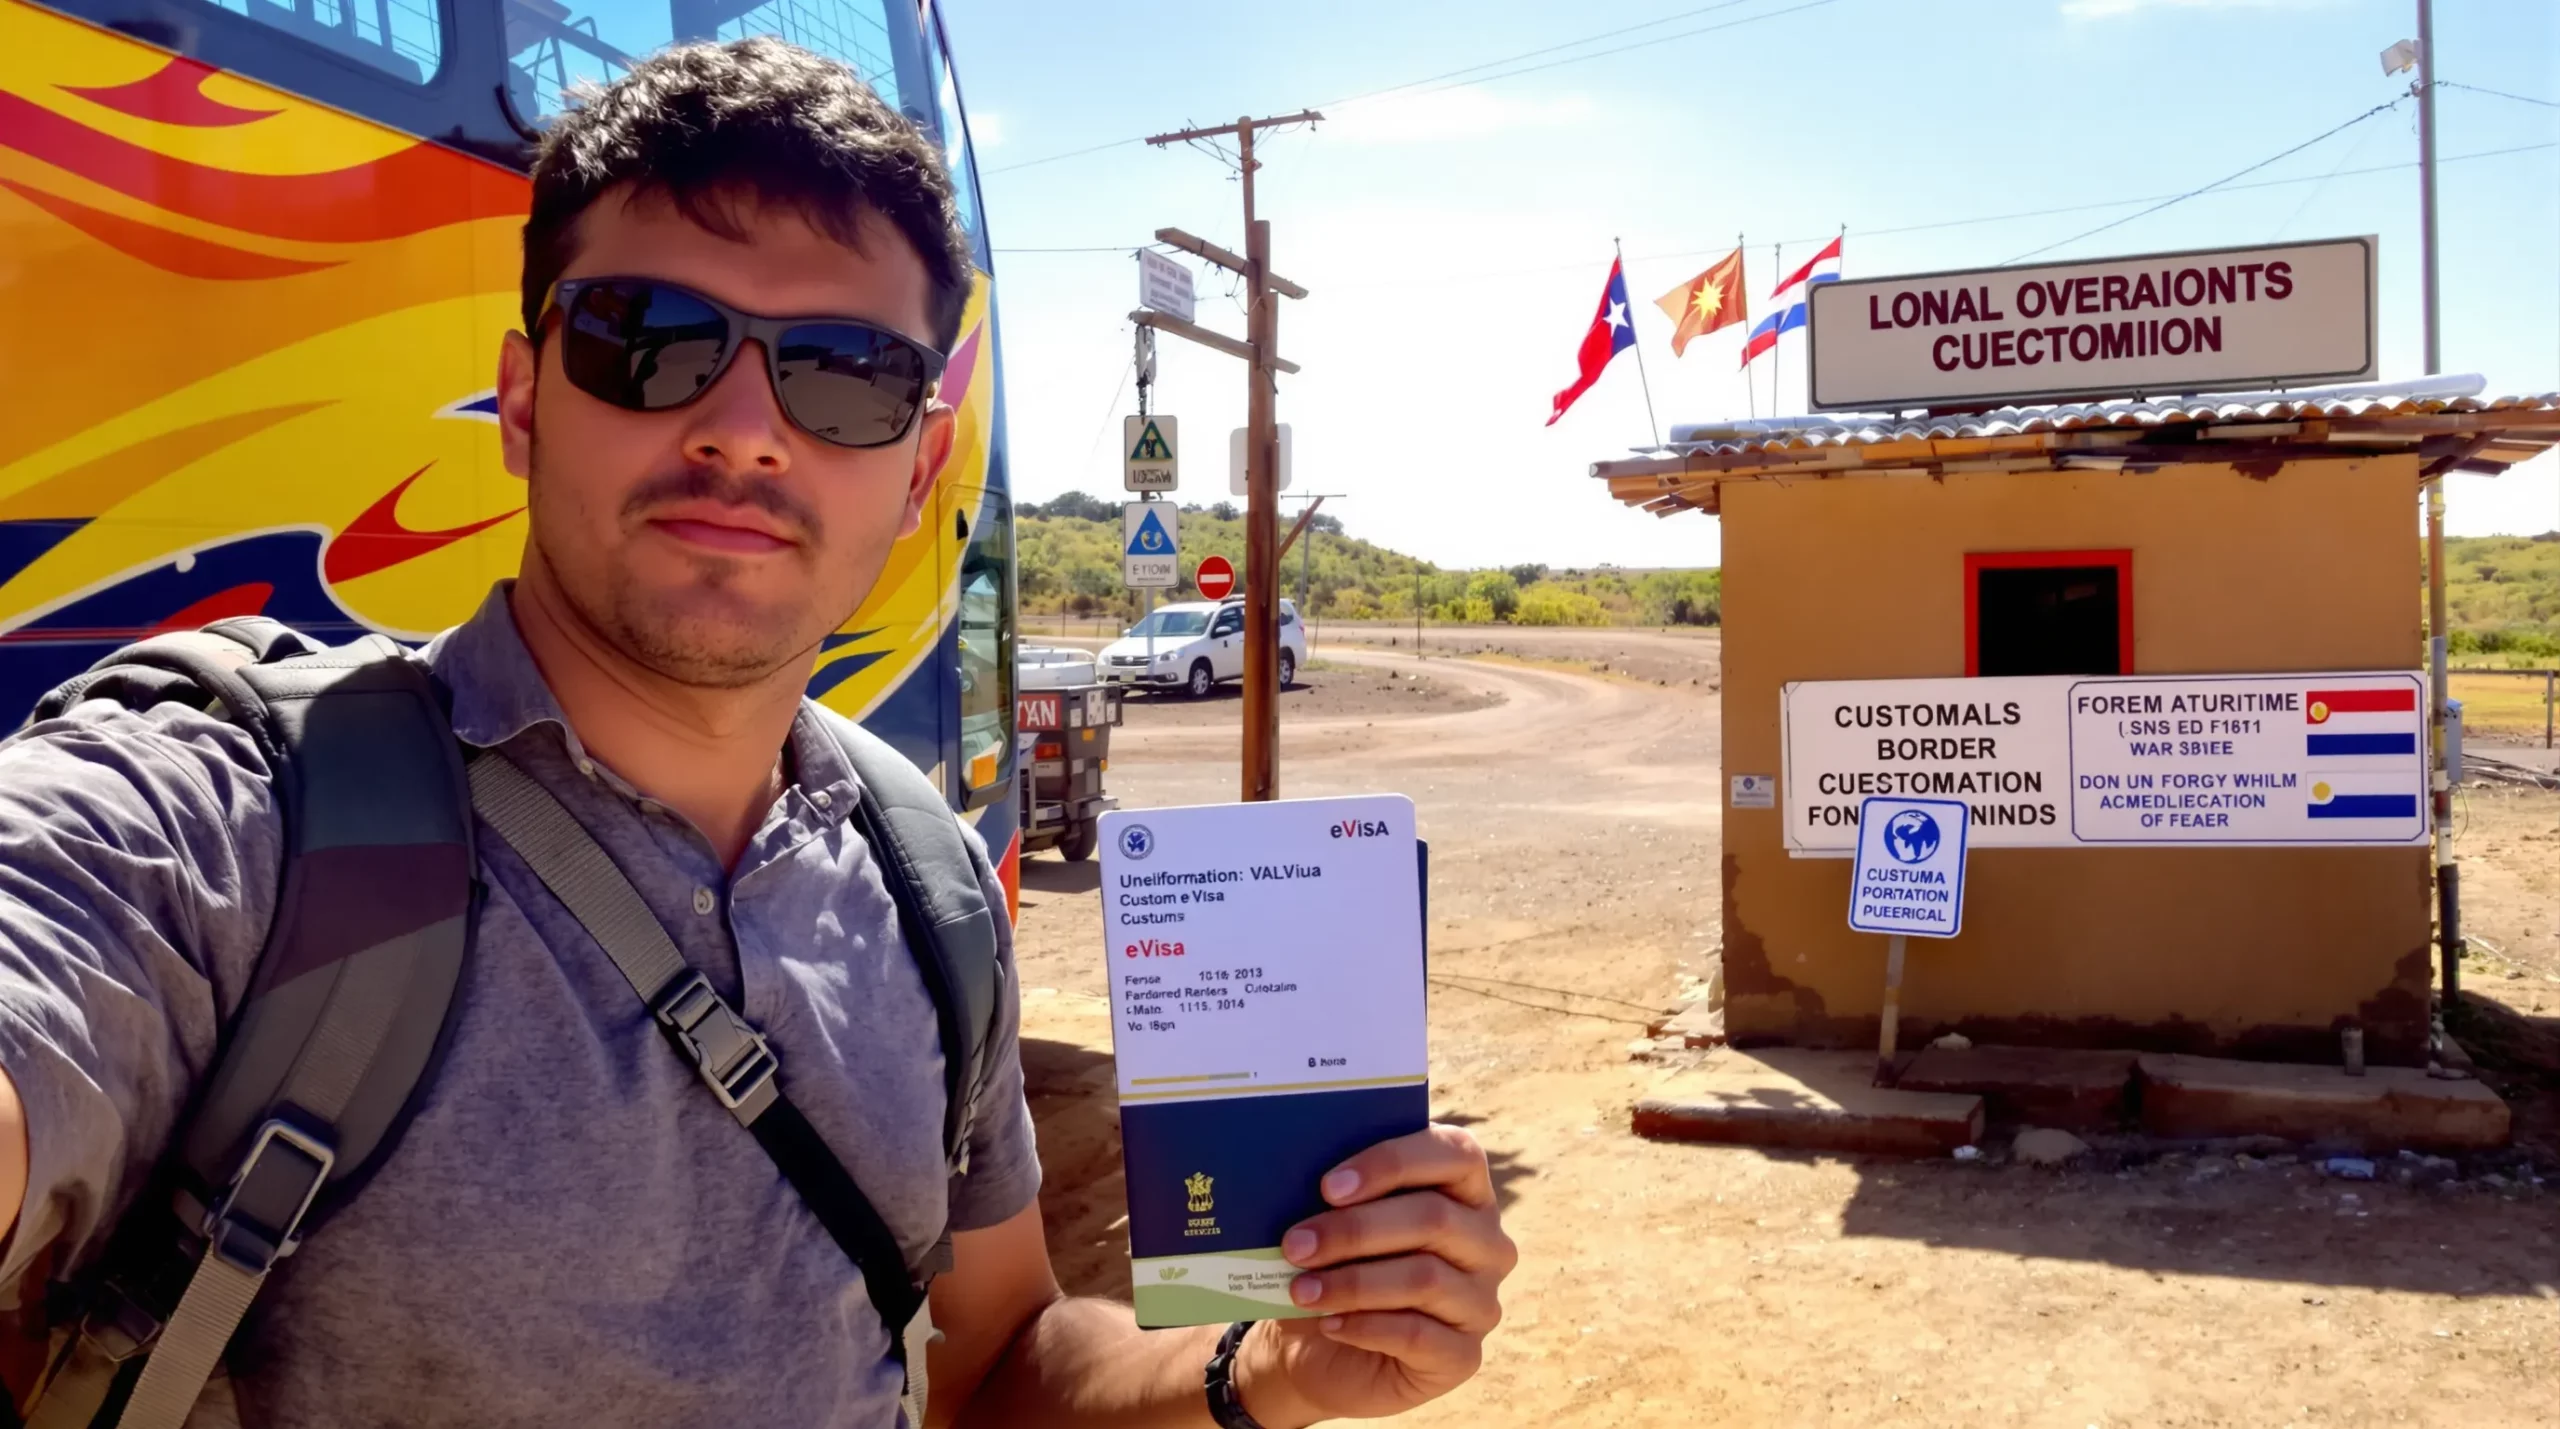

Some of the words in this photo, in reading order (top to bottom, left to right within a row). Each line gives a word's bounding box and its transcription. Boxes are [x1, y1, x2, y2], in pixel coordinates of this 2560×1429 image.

[1868, 286, 2003, 330] LONAL
[2016, 261, 2293, 319] OVERAIONTS
[1932, 315, 2222, 372] CUECTOMIION
[2077, 695, 2163, 714] FOREM
[2171, 693, 2299, 712] ATURITIME
[1834, 702, 2021, 727] CUSTOMALS
[2178, 720, 2204, 734] ED
[1877, 737, 1997, 760] BORDER
[2130, 742, 2173, 756] WAR
[1818, 771, 2042, 795] CUESTOMATION
[2080, 775, 2120, 789] DON
[2127, 775, 2154, 788] UN
[2161, 774, 2228, 789] FORGY
[2233, 773, 2297, 788] WHILM
[2140, 814, 2165, 828] OF
[2169, 813, 2229, 828] FEAER
[1866, 868, 1946, 885] CUSTUMA
[1119, 892, 1177, 907] Custom
[1862, 904, 1947, 923] PUEERICAL
[1125, 938, 1186, 959] eVisa
